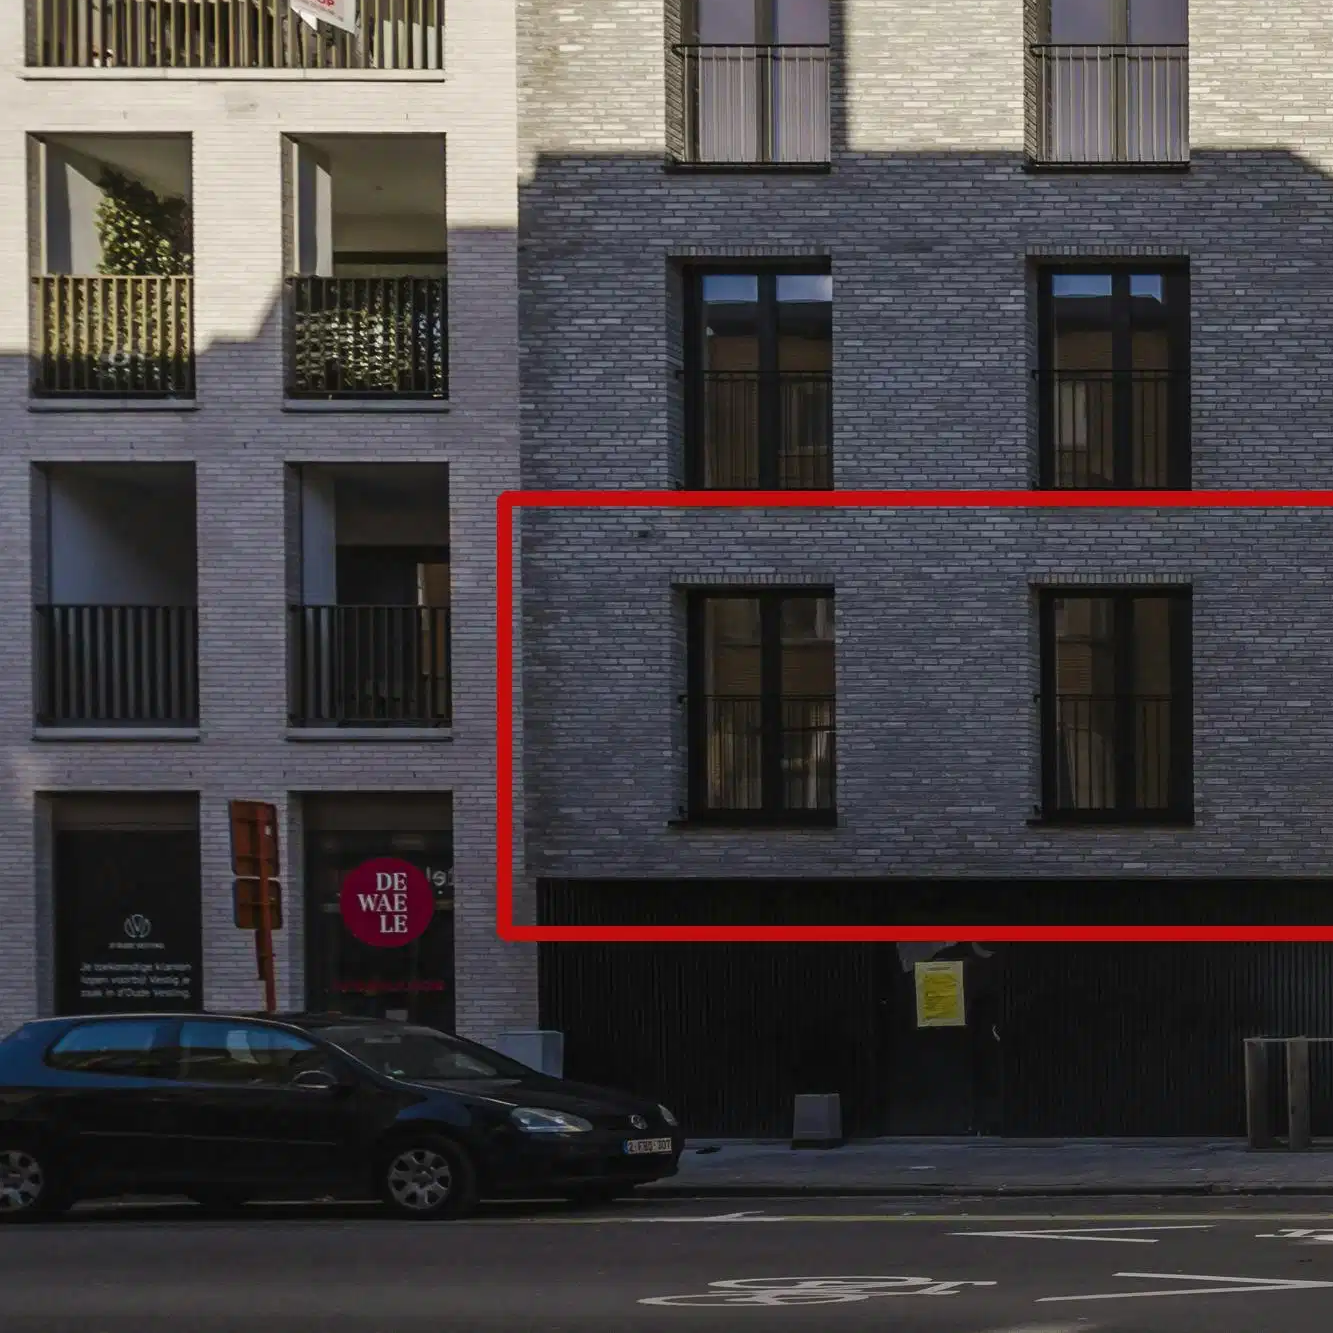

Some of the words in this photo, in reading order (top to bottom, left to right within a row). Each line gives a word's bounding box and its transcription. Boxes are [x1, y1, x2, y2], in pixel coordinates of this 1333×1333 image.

[375, 872, 408, 891] DE
[356, 893, 408, 913] WAE
[379, 914, 408, 933] LE
